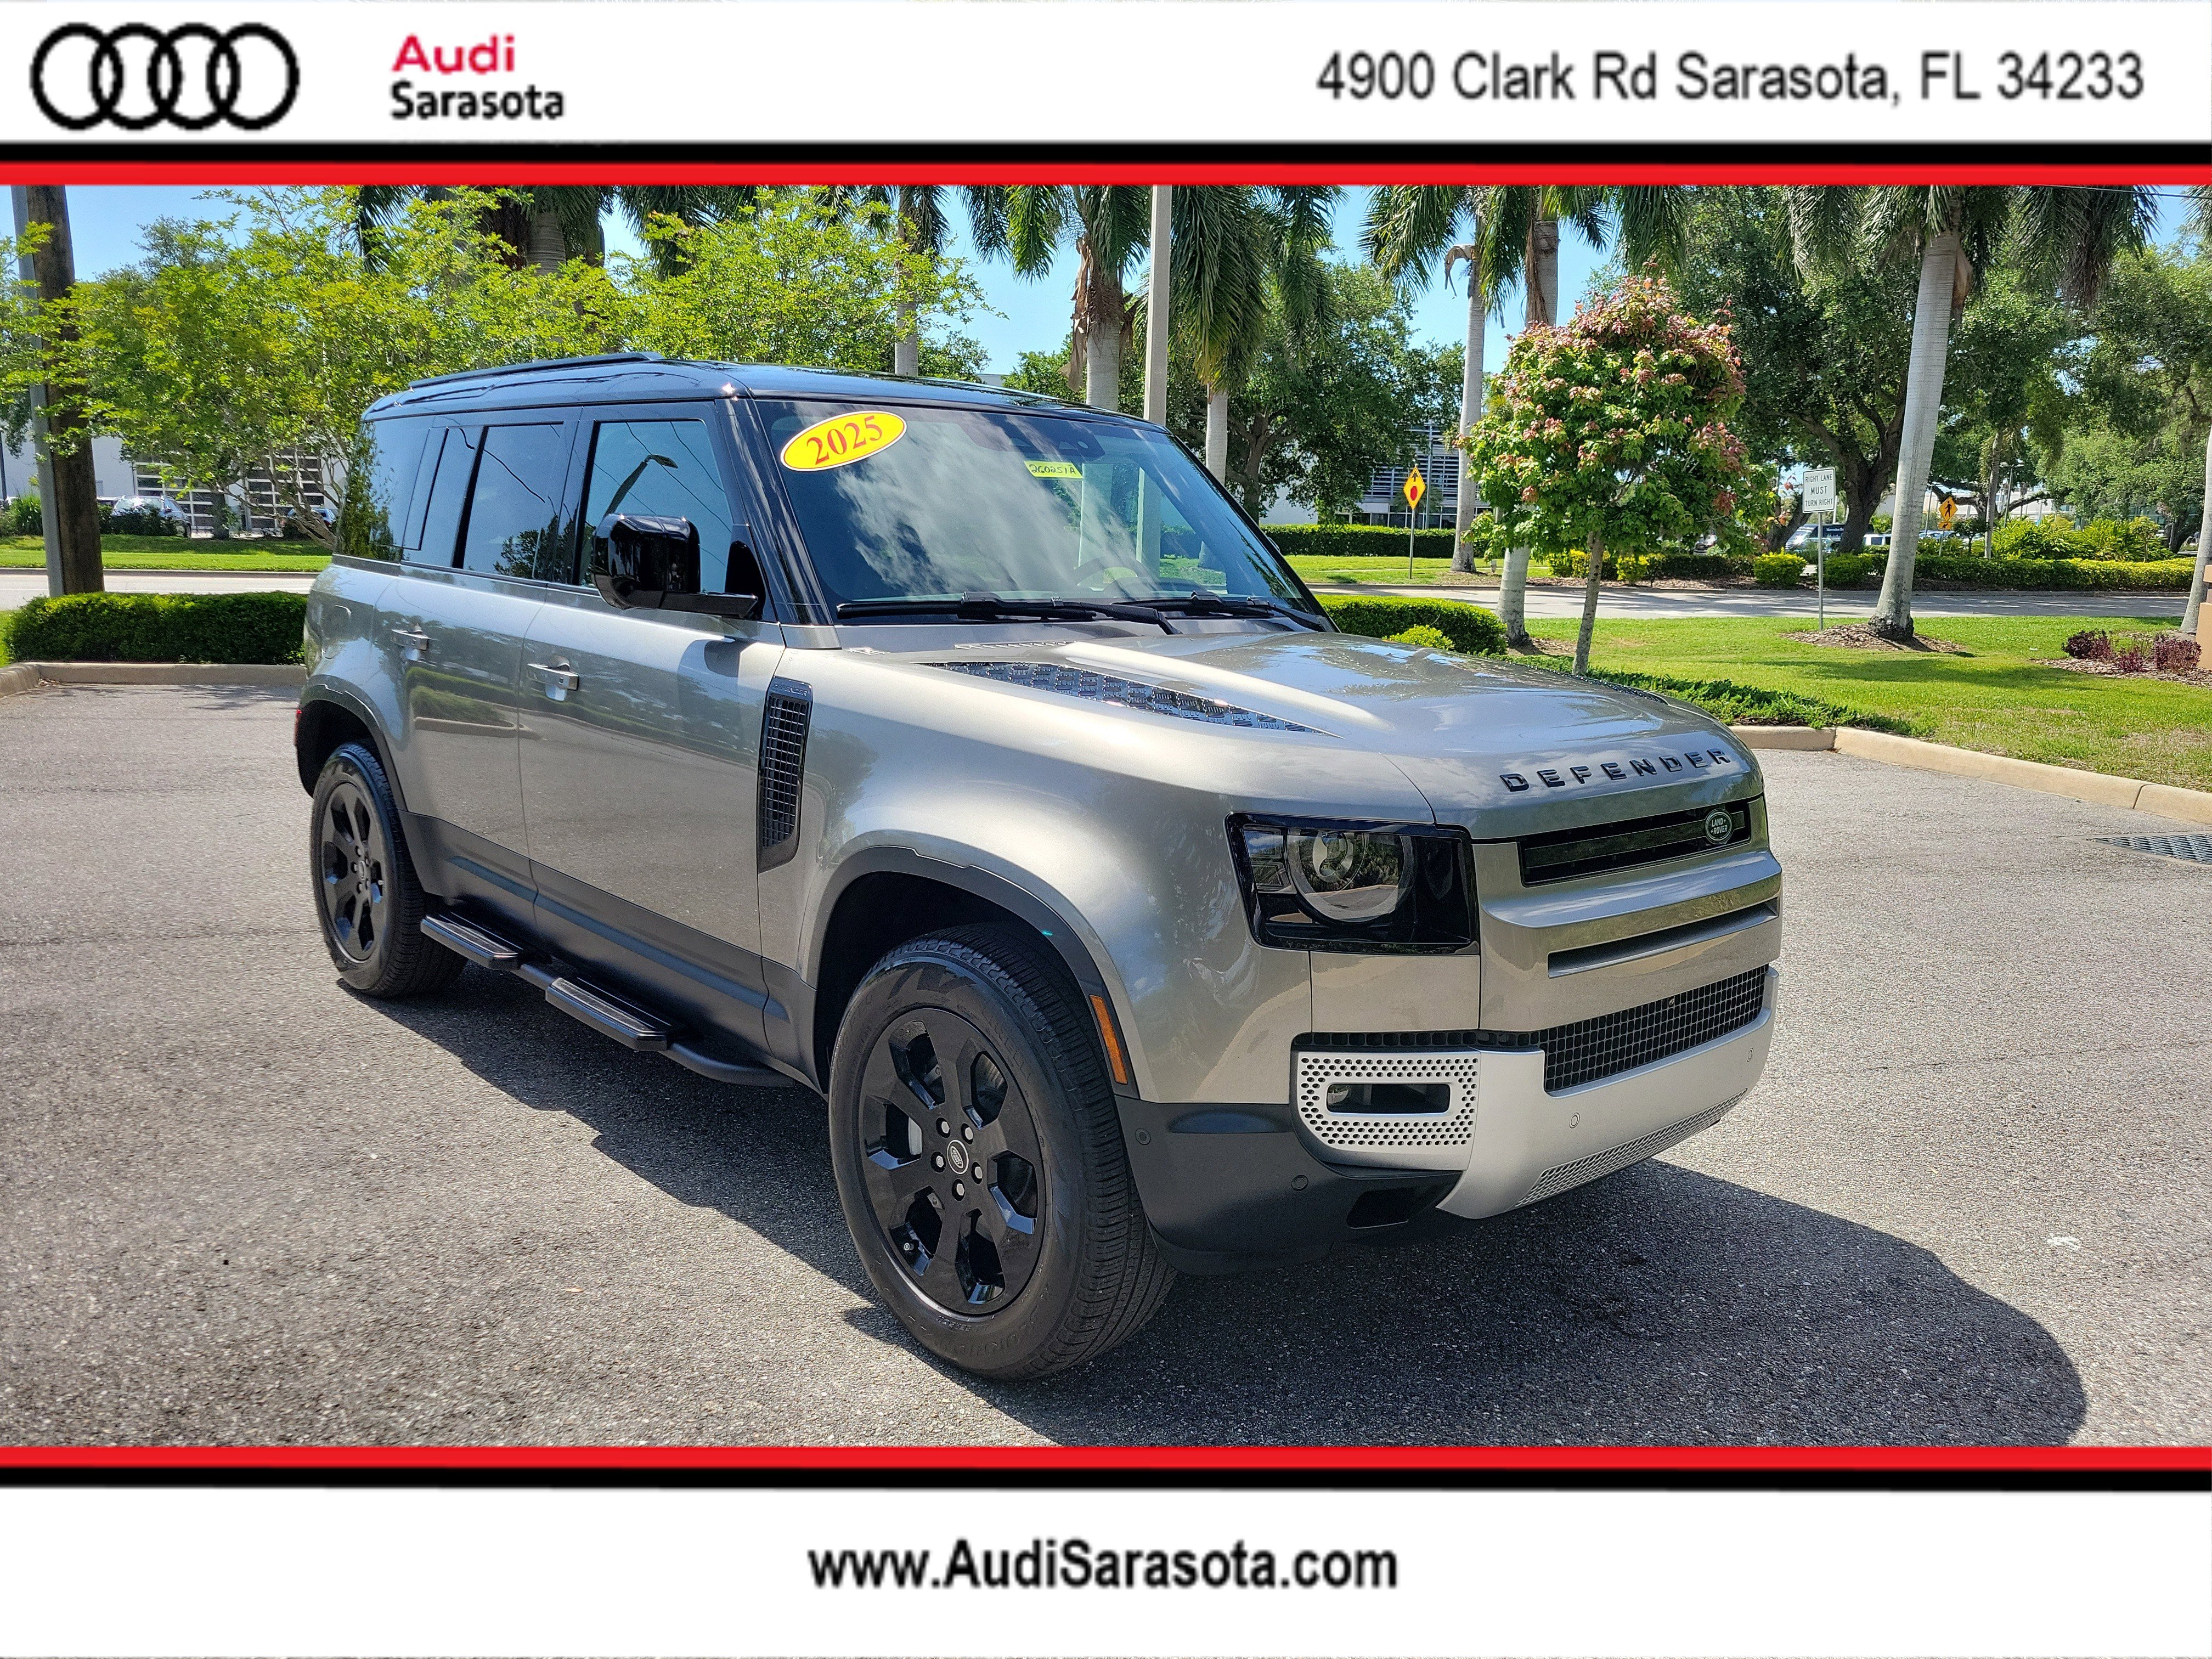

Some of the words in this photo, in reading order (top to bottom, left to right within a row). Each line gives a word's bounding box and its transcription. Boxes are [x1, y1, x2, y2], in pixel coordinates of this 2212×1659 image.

[806, 415, 883, 465] 2025
[1811, 486, 1827, 495] MUST
[774, 684, 808, 696] DEFENDER
[1499, 748, 1732, 792] DEFENDER
[1712, 817, 1723, 827] LAND
[1713, 825, 1728, 835] ROVER
